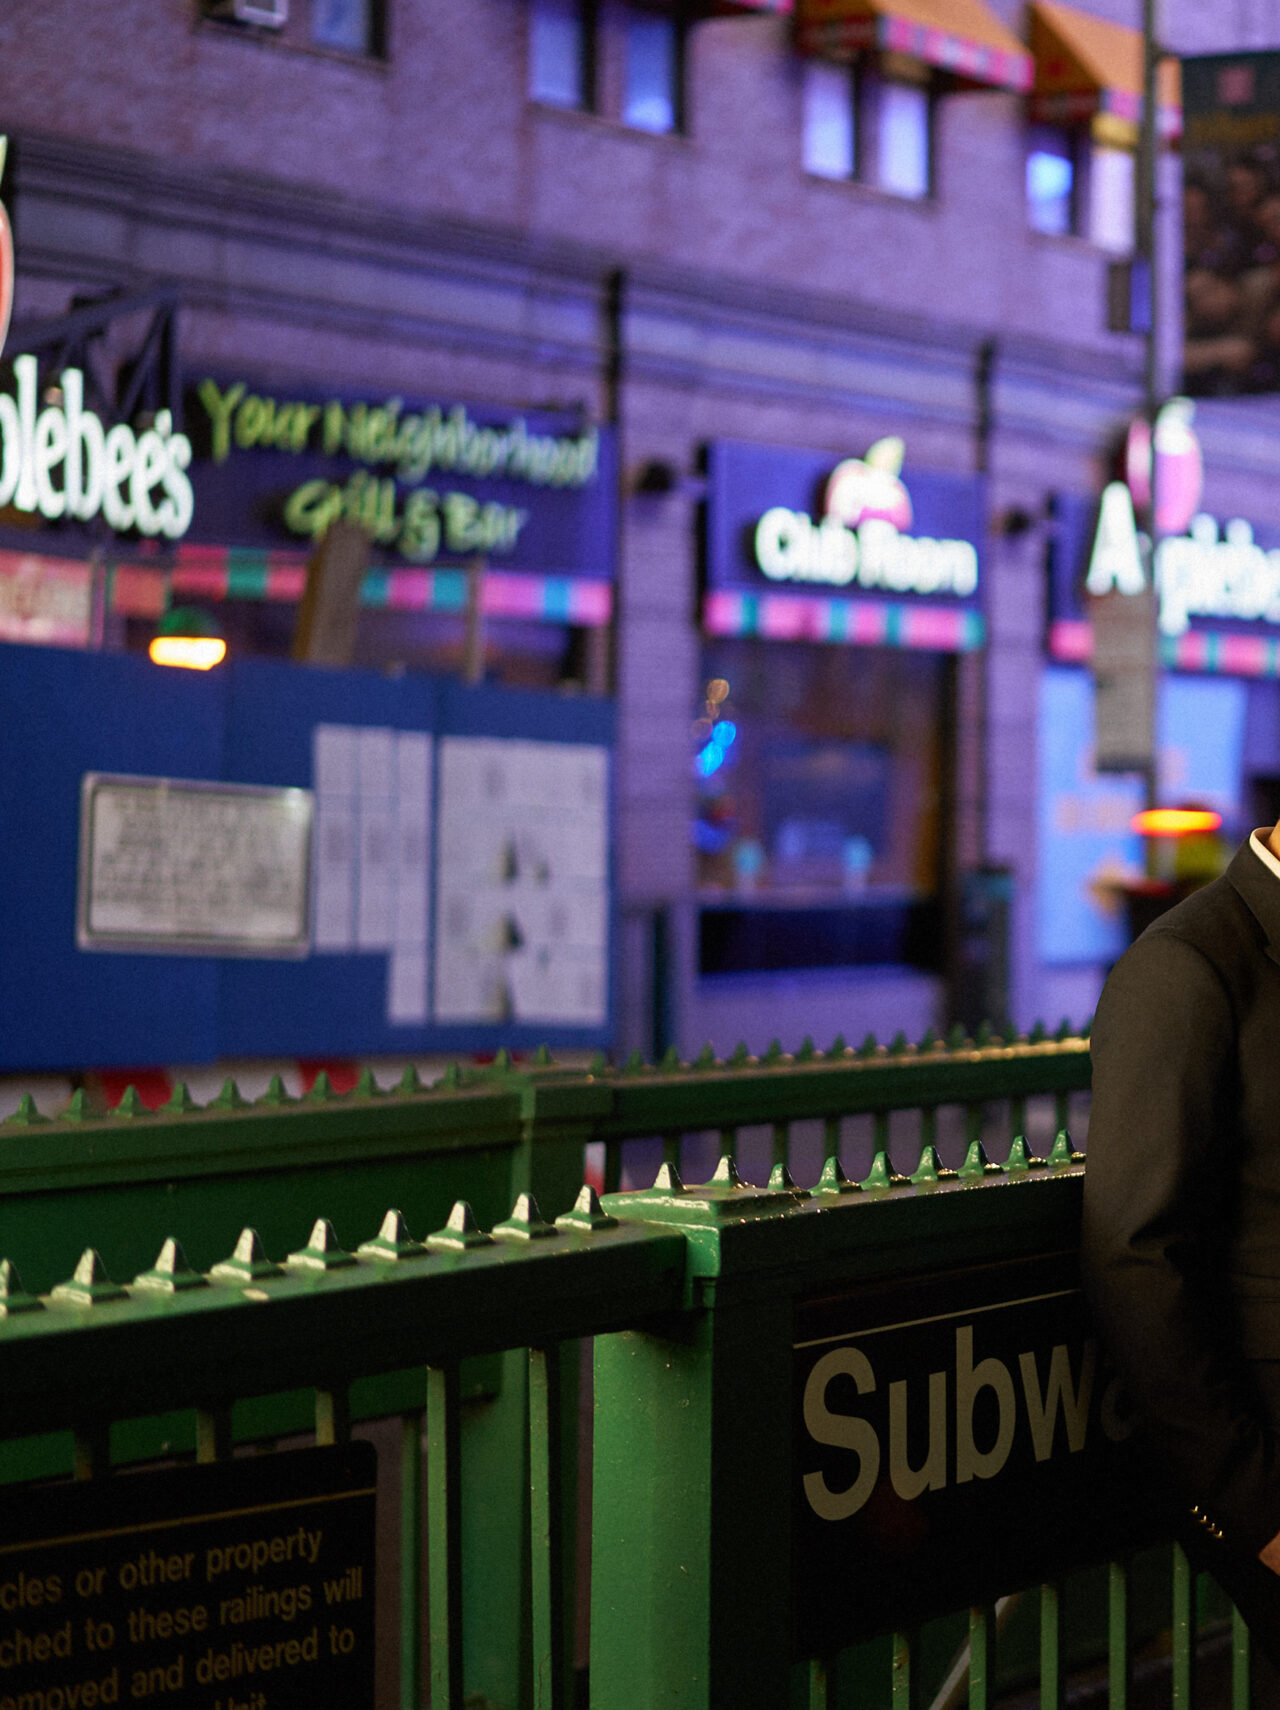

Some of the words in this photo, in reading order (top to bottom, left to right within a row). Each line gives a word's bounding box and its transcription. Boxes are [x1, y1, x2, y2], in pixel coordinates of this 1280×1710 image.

[198, 377, 320, 464] Your
[323, 395, 599, 488] Neighborhood
[446, 490, 529, 555] Bar
[756, 507, 858, 585] Club
[859, 518, 978, 596] Room
[802, 1325, 1128, 1521] Subw
[0, 1571, 62, 1612] cles
[75, 1565, 108, 1598] or
[119, 1549, 196, 1590] other
[205, 1527, 323, 1582] property
[0, 1620, 73, 1669] ched
[85, 1617, 116, 1651] to
[128, 1608, 208, 1643] these
[219, 1582, 312, 1625] railings
[323, 1565, 364, 1605] will
[130, 1654, 185, 1699] and
[195, 1626, 319, 1685] delivered
[330, 1624, 356, 1655] to
